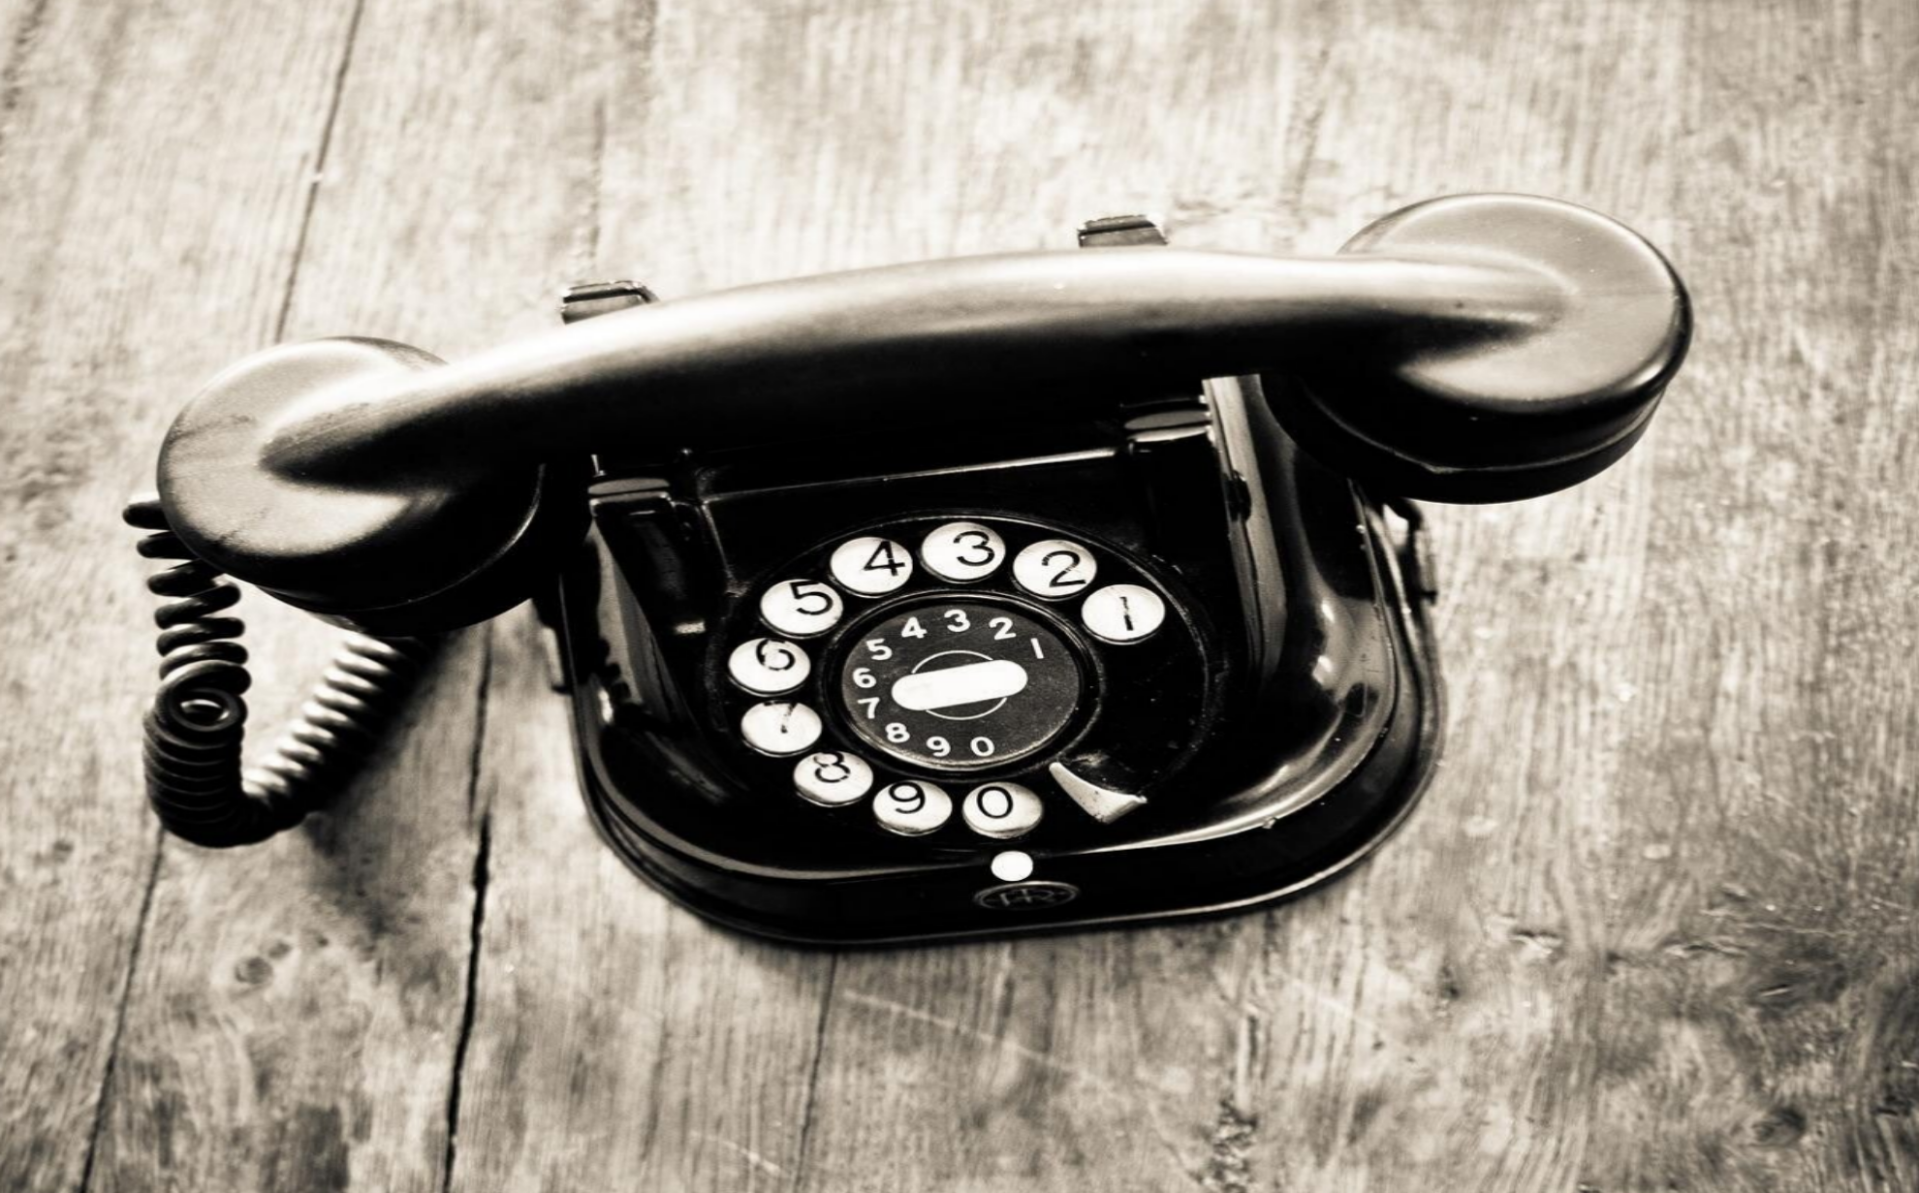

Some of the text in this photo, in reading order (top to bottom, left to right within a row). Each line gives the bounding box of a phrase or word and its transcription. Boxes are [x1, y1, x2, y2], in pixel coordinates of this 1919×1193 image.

[862, 540, 906, 577] 4
[953, 530, 996, 567] 3
[1041, 550, 1087, 588] 2
[789, 580, 834, 616] 5
[944, 609, 971, 633] 3
[1119, 596, 1134, 631] 1
[901, 616, 928, 639] 4
[988, 617, 1017, 640] 2
[755, 637, 796, 671] 6
[865, 638, 893, 661] 5
[1030, 637, 1044, 659] 1
[852, 667, 877, 689] 6
[857, 696, 881, 719] 7
[885, 722, 911, 743] 8
[926, 736, 951, 757] 9
[970, 736, 995, 757] 0
[813, 751, 850, 783] 8
[888, 781, 926, 814] 9
[976, 786, 1014, 819] 0
